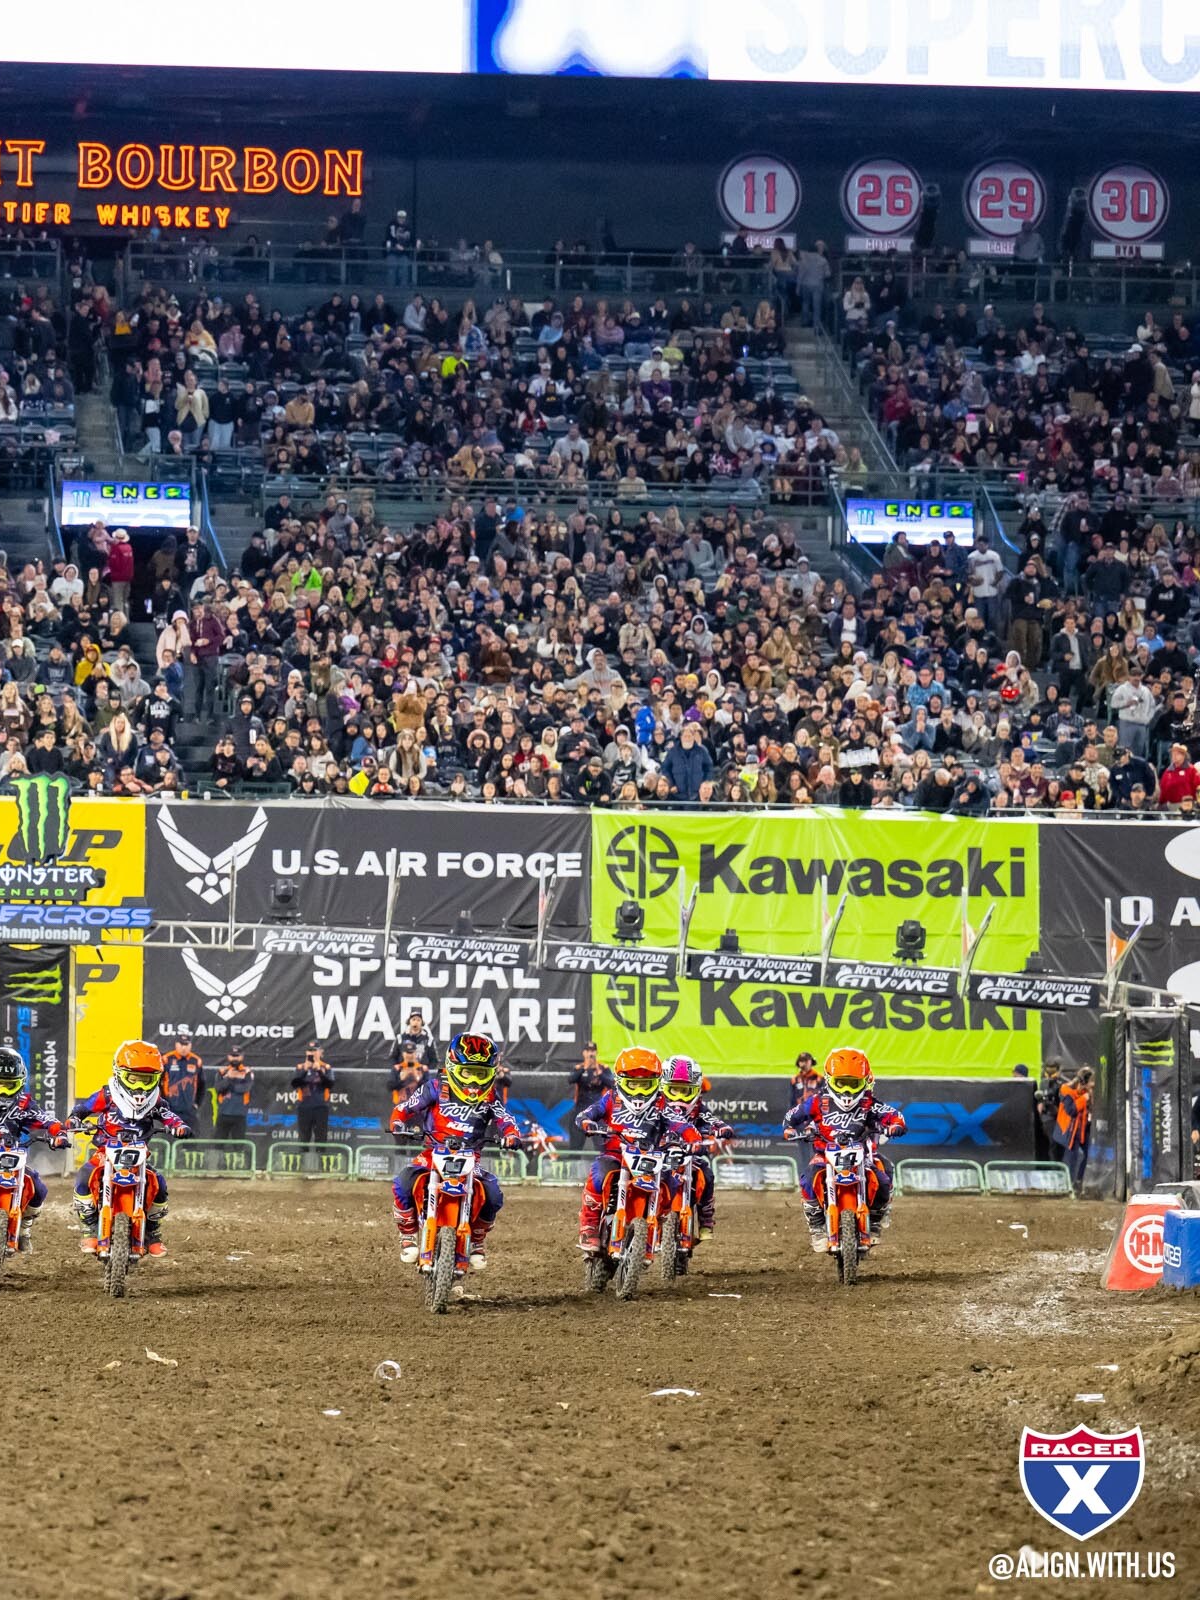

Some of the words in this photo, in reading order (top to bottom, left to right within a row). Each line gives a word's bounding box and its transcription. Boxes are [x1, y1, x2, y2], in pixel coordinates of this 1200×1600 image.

[79, 142, 363, 196] BOURBON
[742, 170, 777, 214] 11
[856, 174, 913, 217] 26
[977, 177, 1036, 219] 29
[1101, 180, 1157, 223] 30
[97, 204, 231, 229] WHISKEY
[271, 850, 348, 875] U.S.
[355, 851, 428, 877] AIR
[437, 852, 583, 878] FORCE
[699, 844, 1025, 898] Kawasaki
[280, 929, 315, 940] ROCKY
[317, 932, 375, 943] MOUNTAIN
[425, 937, 460, 948] ROCKY
[462, 940, 520, 952] MOUNTAIN
[573, 946, 608, 957] ROCKY
[611, 951, 669, 963] MOUNTAIN
[718, 956, 753, 967] ROCKY
[755, 959, 813, 971] MOUNTAIN
[854, 965, 889, 976] ROCKY
[891, 967, 949, 980] MOUNTAIN
[996, 977, 1032, 989] ROCKY
[1034, 980, 1091, 993] MOUNTAIN
[310, 995, 576, 1043] WARFARE
[159, 1023, 193, 1037] U.S.
[195, 1024, 227, 1037] AIR
[230, 1025, 295, 1039] FORCE
[701, 1098, 768, 1114] ONSTER
[446, 1121, 475, 1133] KTM
[834, 1152, 858, 1167] 14
